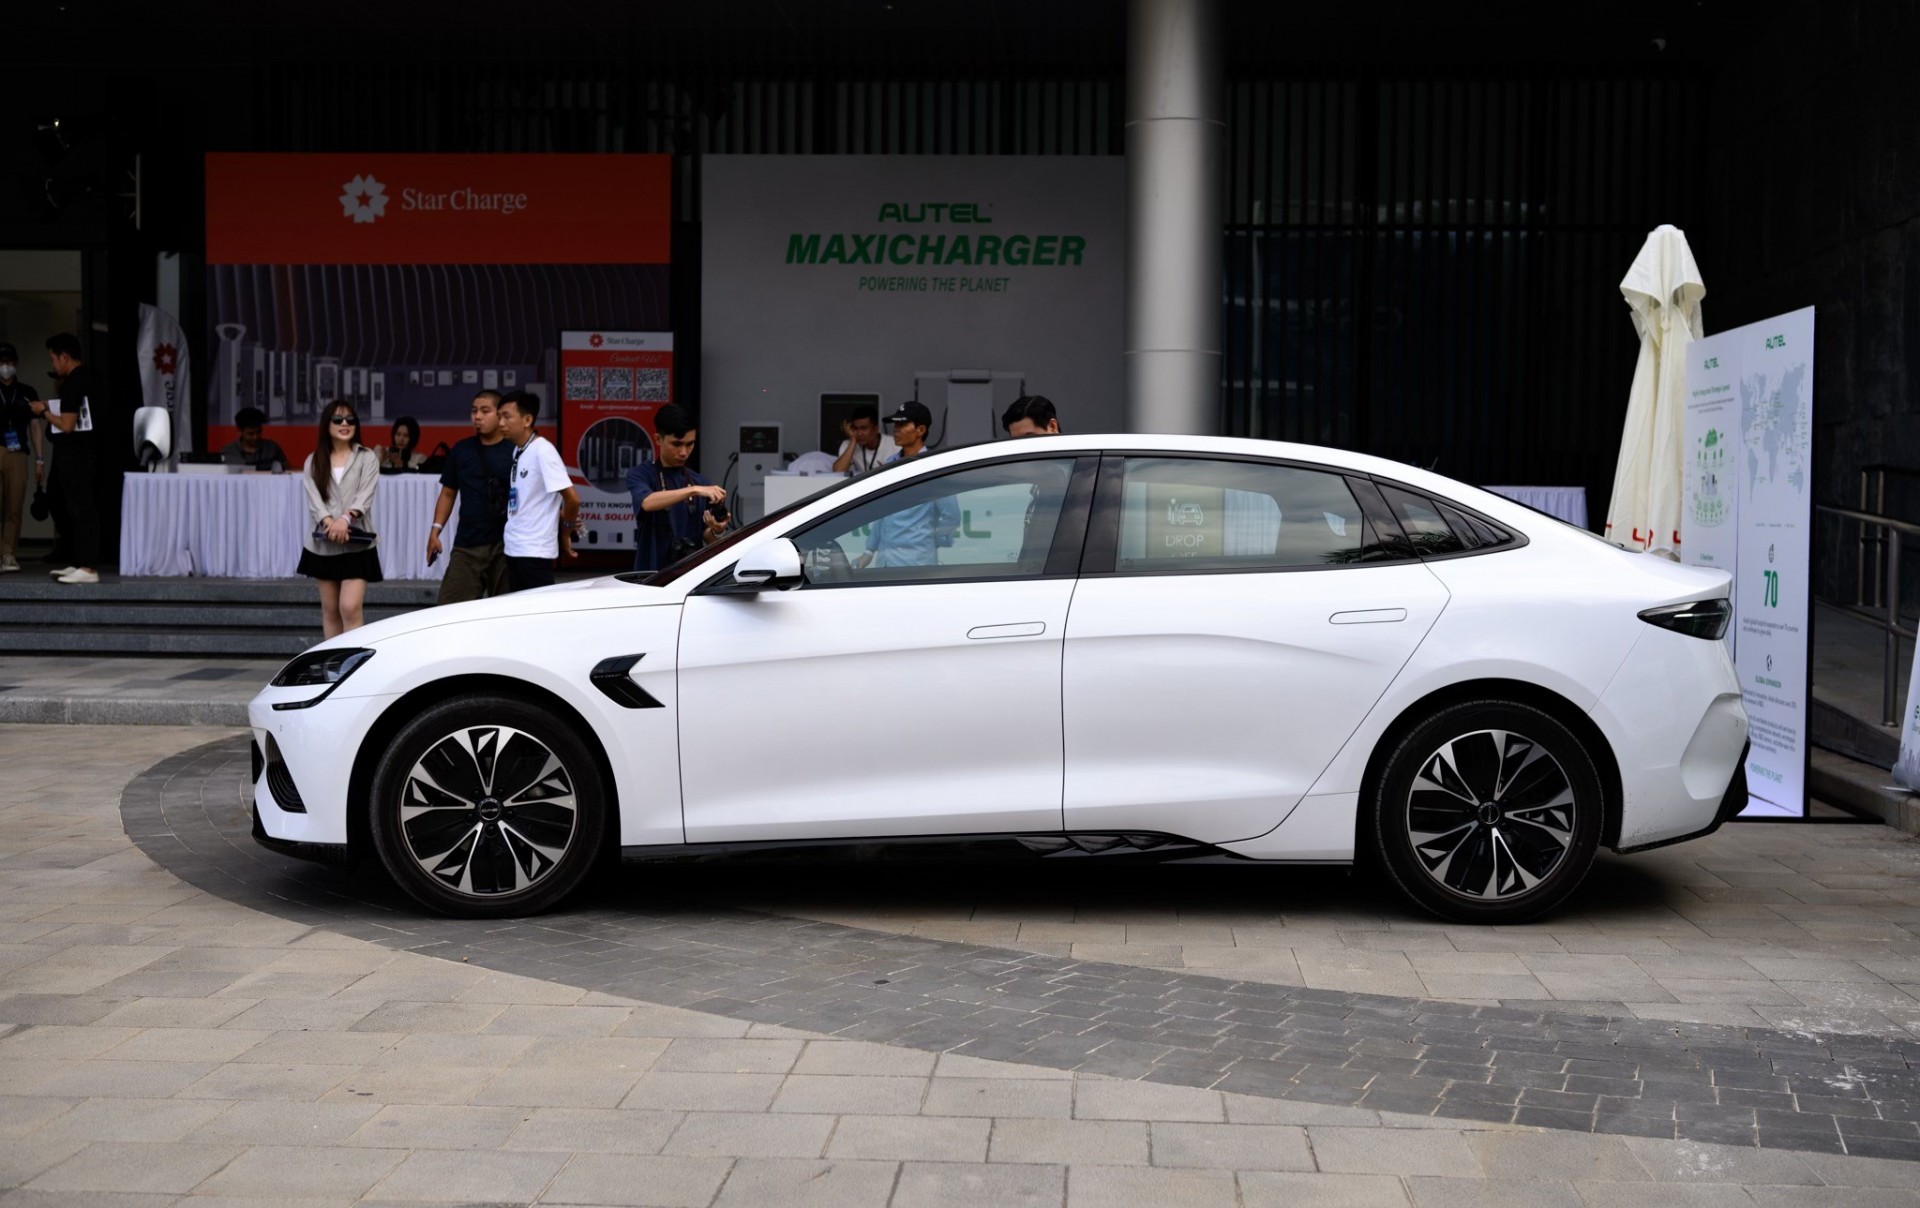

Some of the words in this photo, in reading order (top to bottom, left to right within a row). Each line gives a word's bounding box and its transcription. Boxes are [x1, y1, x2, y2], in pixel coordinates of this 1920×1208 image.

[878, 203, 991, 223] AUTEL
[785, 234, 1086, 266] MAXICHARGER
[859, 276, 927, 292] POWERING
[931, 277, 955, 292] THE
[959, 277, 1010, 292] PLANET
[1165, 534, 1204, 548] DROP
[1764, 570, 1778, 608] 70
